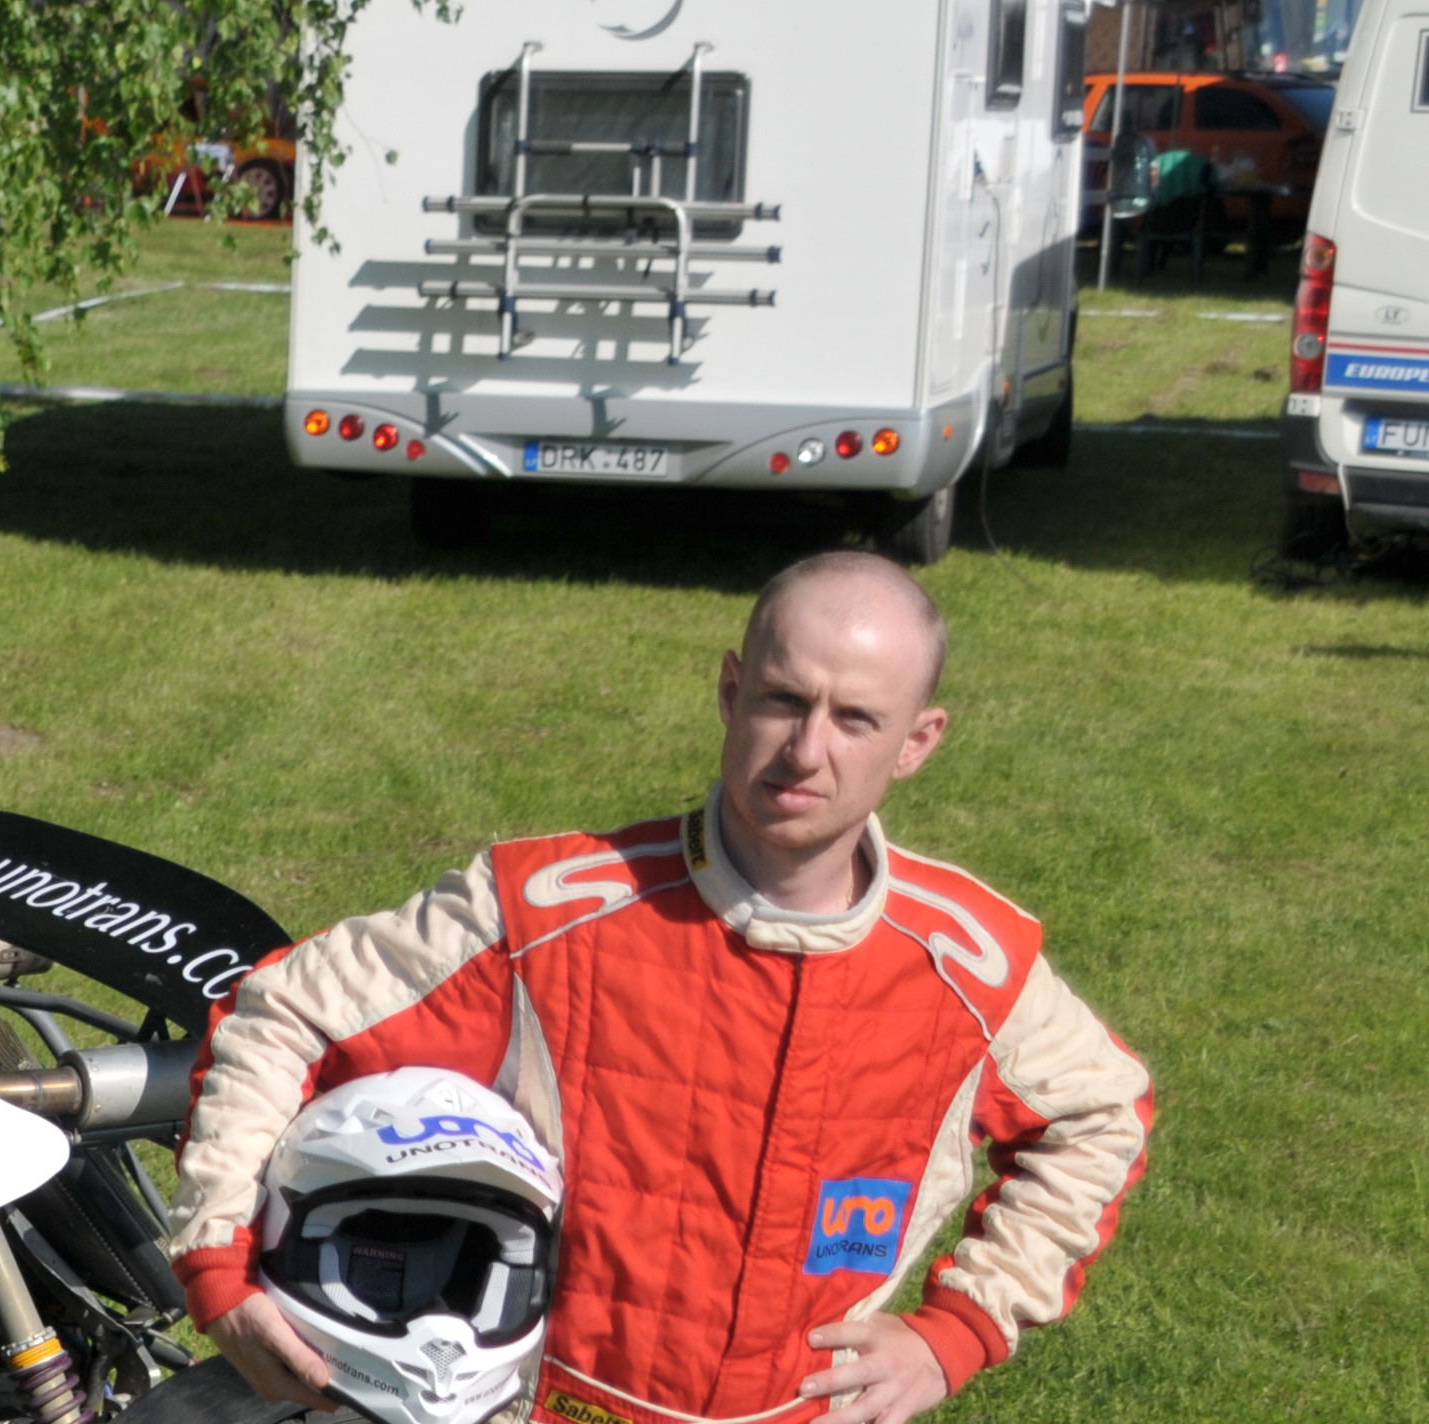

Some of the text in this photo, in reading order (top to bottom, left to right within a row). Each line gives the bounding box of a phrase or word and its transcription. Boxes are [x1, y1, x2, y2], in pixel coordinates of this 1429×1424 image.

[616, 448, 664, 472] 487
[352, 1246, 406, 1261] WARNING
[816, 1239, 888, 1259] UNORANS
